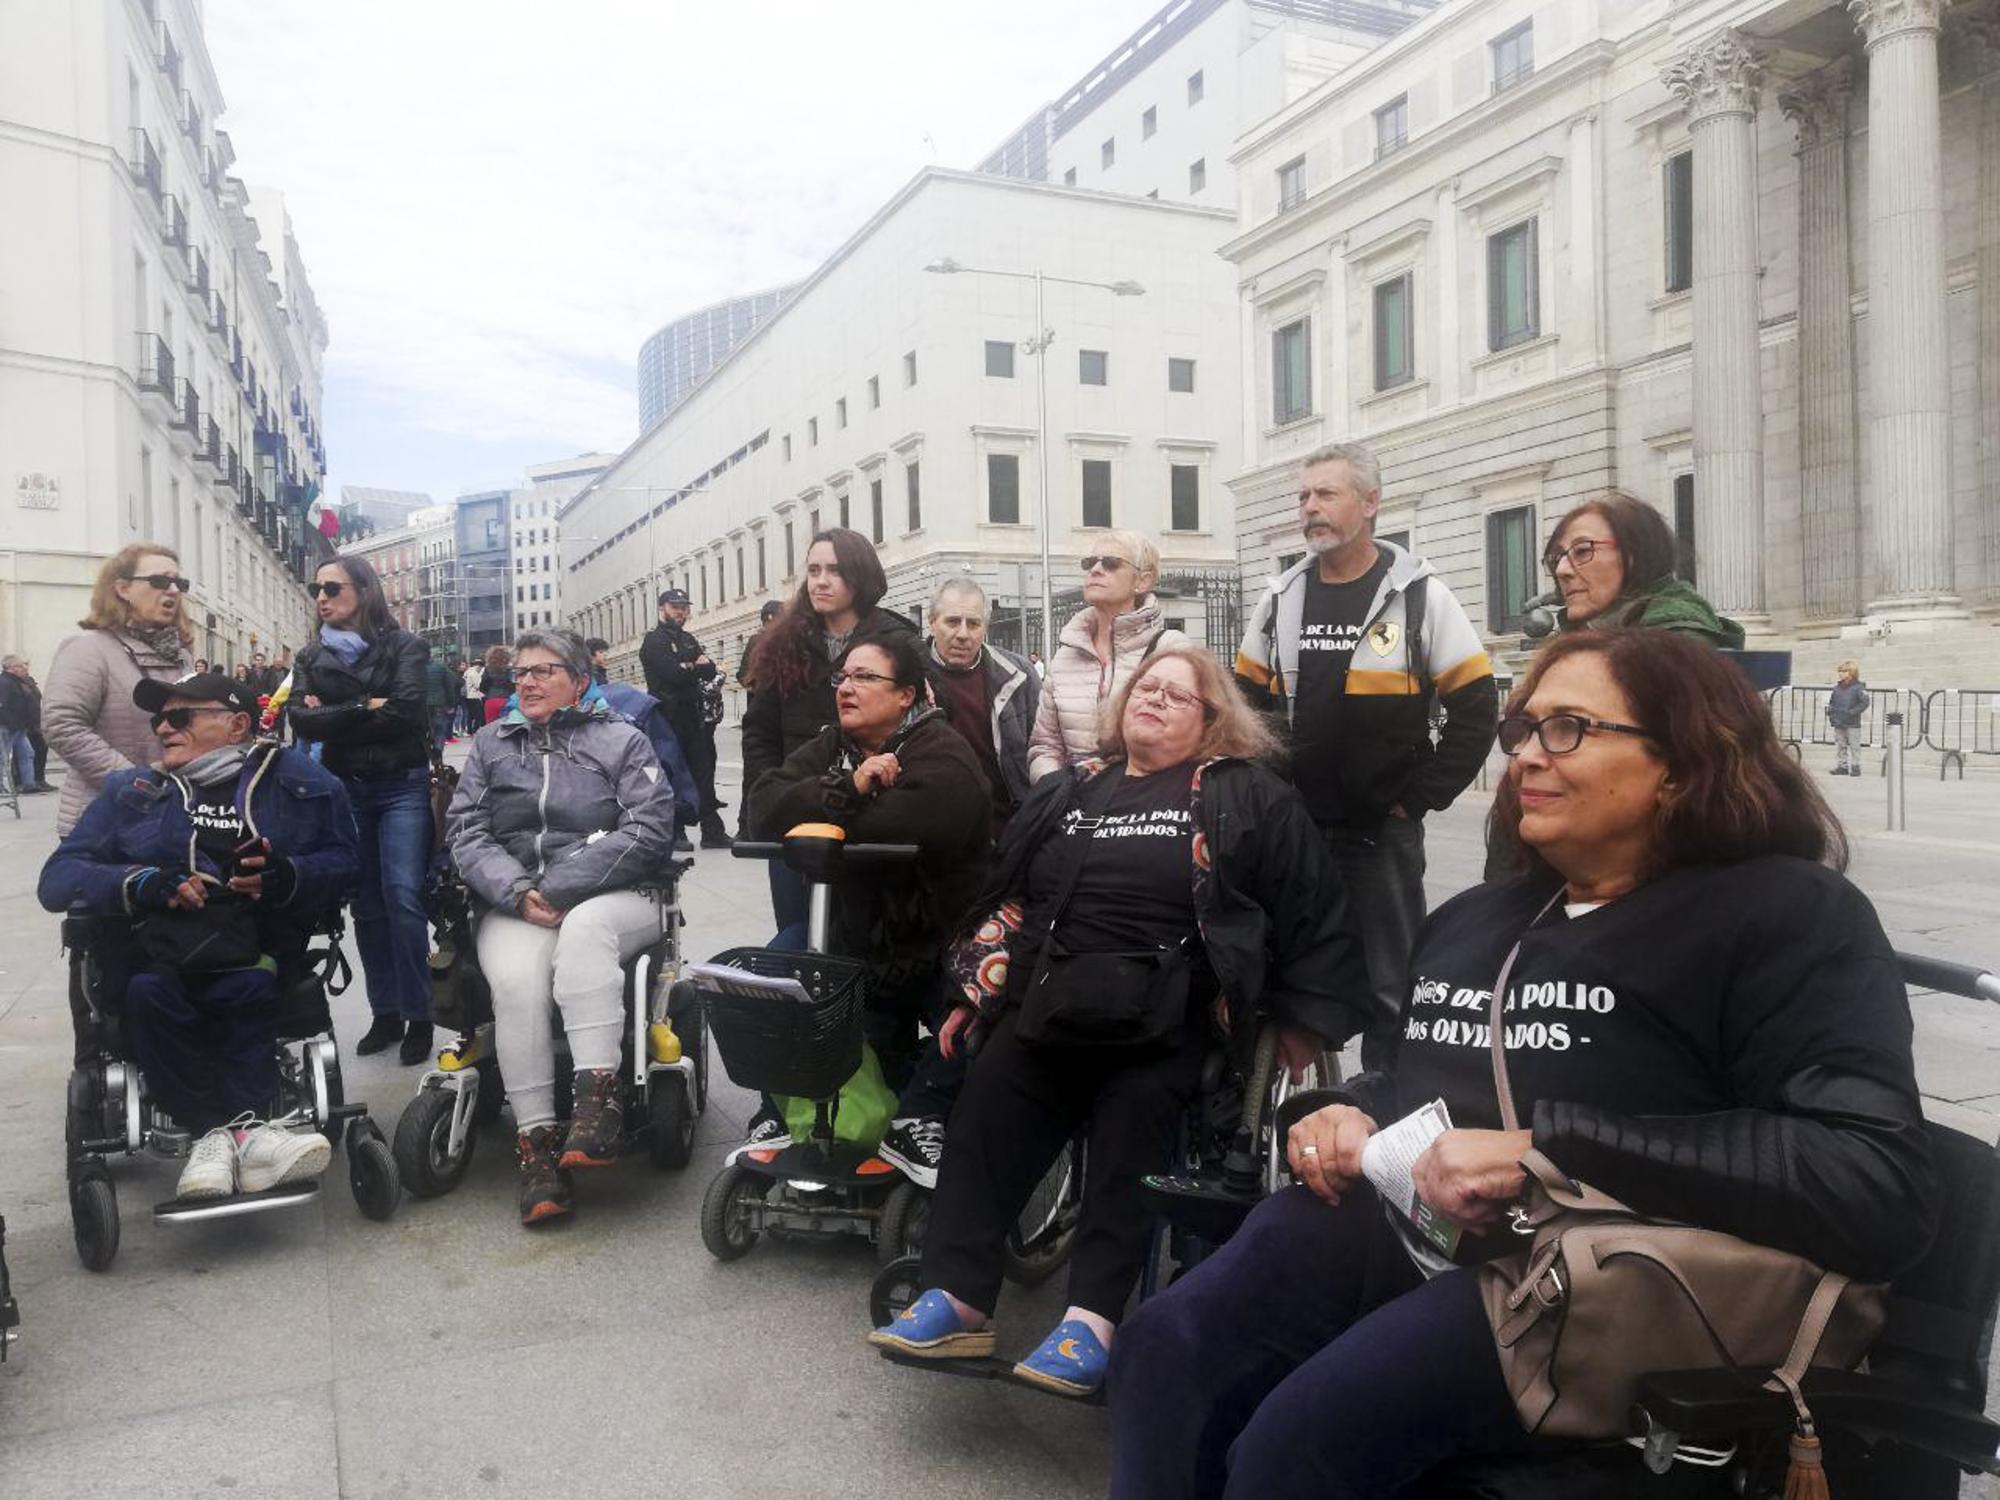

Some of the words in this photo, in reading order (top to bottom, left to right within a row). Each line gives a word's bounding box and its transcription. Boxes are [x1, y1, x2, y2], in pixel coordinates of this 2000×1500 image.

[1306, 624, 1325, 636] DE
[1326, 624, 1344, 636] LA
[198, 804, 216, 816] DE
[219, 805, 236, 816] LA
[1128, 812, 1147, 824] LA
[1092, 825, 1178, 839] OLVIDADOS
[1450, 988, 1495, 1011] DE
[1522, 981, 1616, 1013] POLIO
